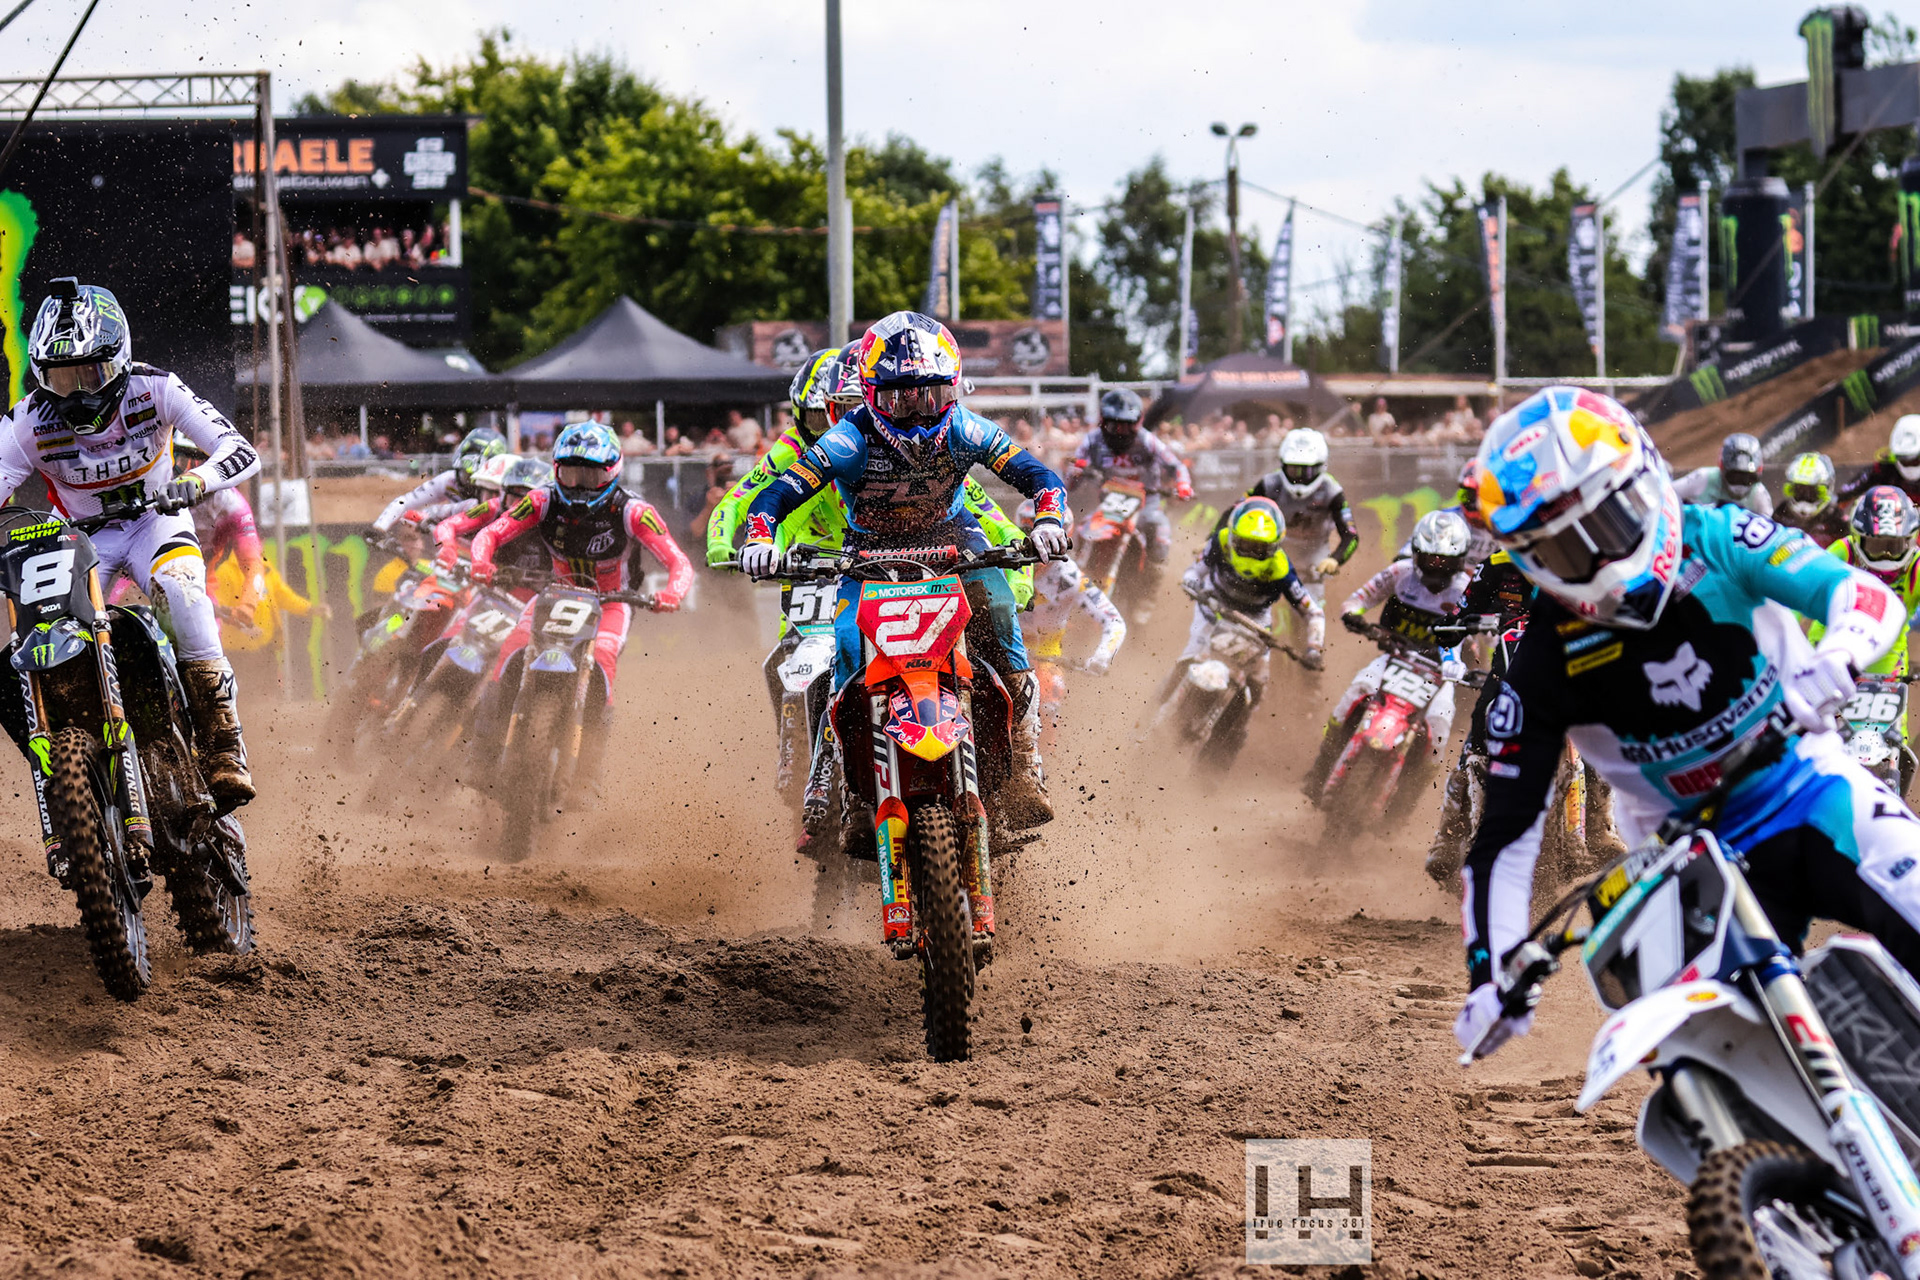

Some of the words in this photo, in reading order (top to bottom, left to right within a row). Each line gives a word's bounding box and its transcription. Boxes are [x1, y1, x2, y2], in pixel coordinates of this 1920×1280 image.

[127, 391, 152, 409] MX2
[20, 549, 76, 606] 8
[878, 585, 929, 598] MOTOREX
[931, 581, 959, 593] MX2
[541, 599, 593, 635] 9
[875, 597, 959, 657] 27
[905, 658, 932, 669] KTM
[1653, 664, 1778, 759] Husqvarna
[1842, 691, 1901, 721] 36
[33, 769, 53, 835] DUNLOP
[878, 845, 890, 900] MOTOREX
